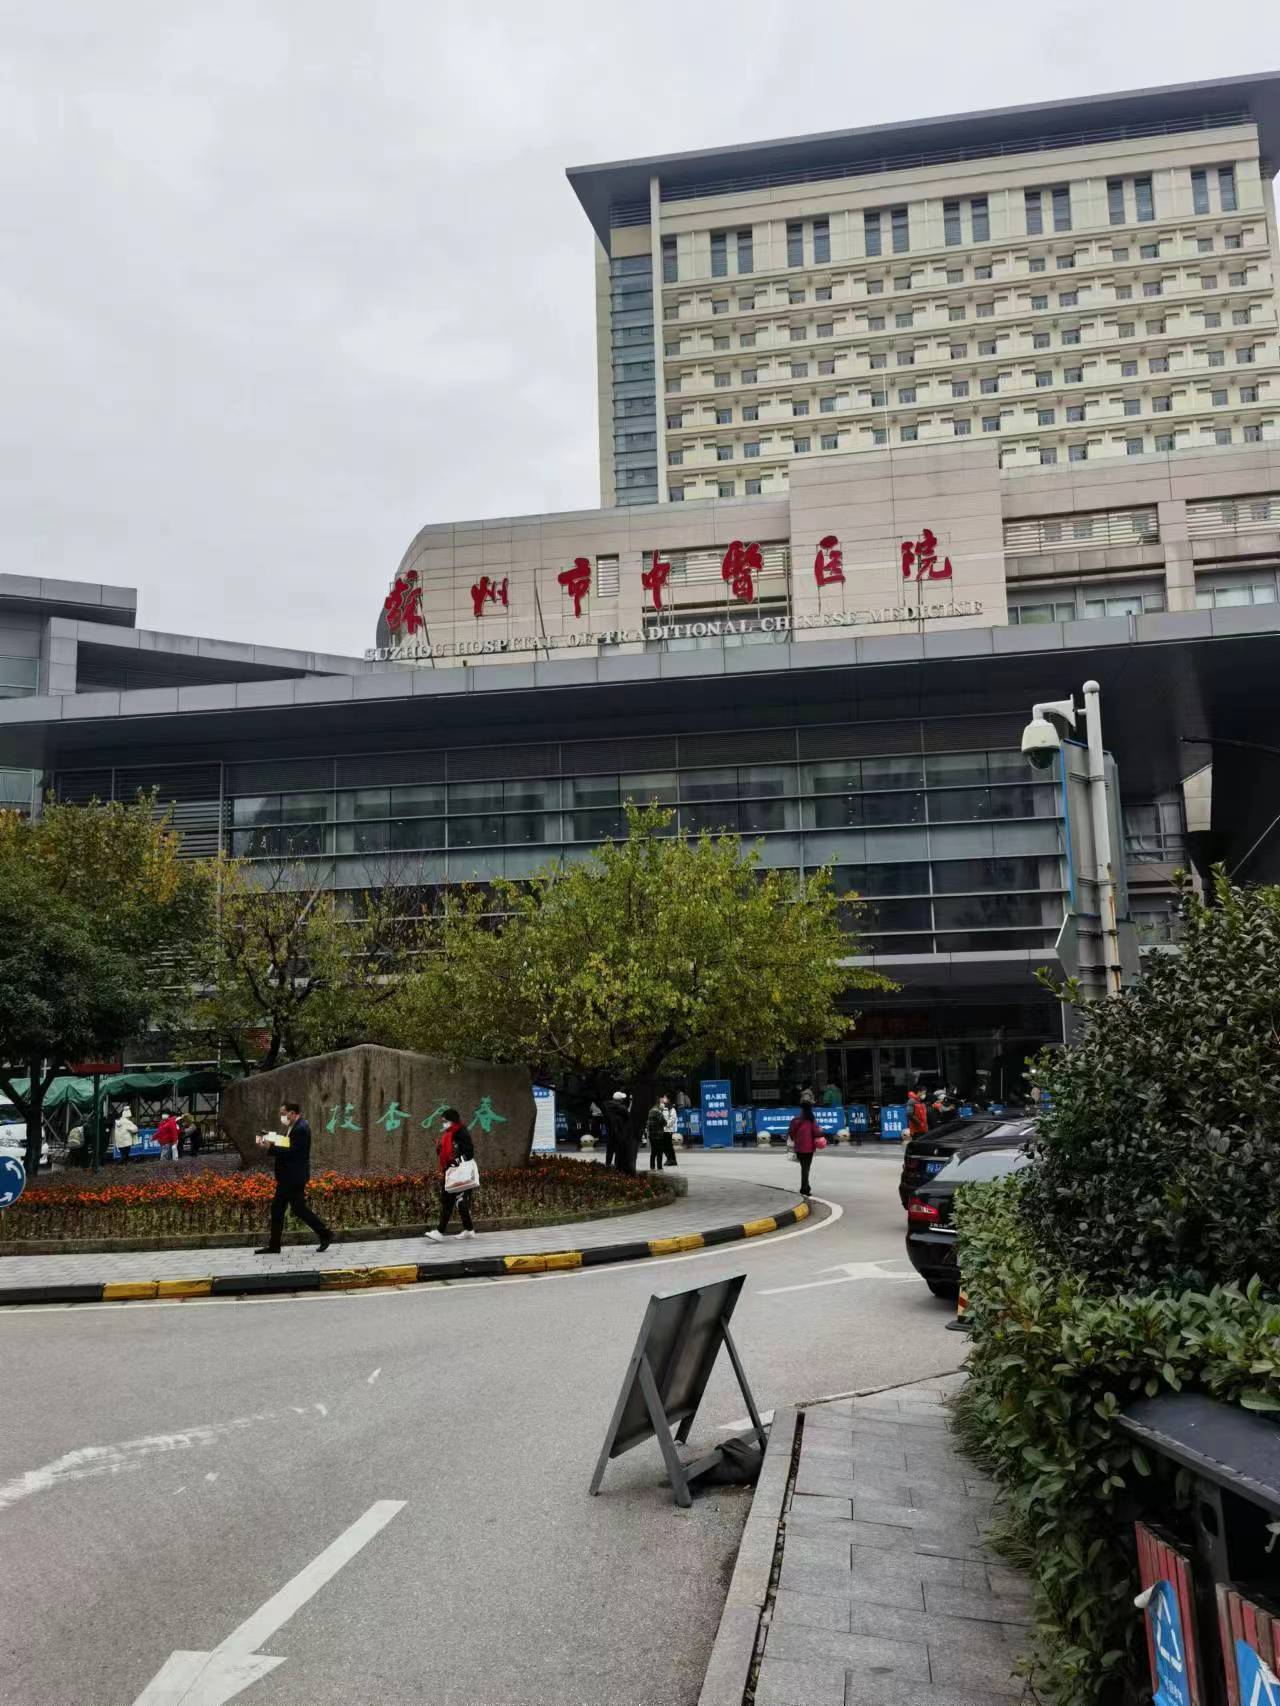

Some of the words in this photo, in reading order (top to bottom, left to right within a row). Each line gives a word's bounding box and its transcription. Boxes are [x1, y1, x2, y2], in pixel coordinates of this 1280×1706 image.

[363, 643, 445, 662] SUZHOU
[454, 635, 557, 655] HOSPITAL
[567, 632, 595, 647] OF
[600, 619, 752, 644] TRADITIONAL
[760, 611, 857, 632] CHINESE
[870, 601, 983, 622] MEDICINE
